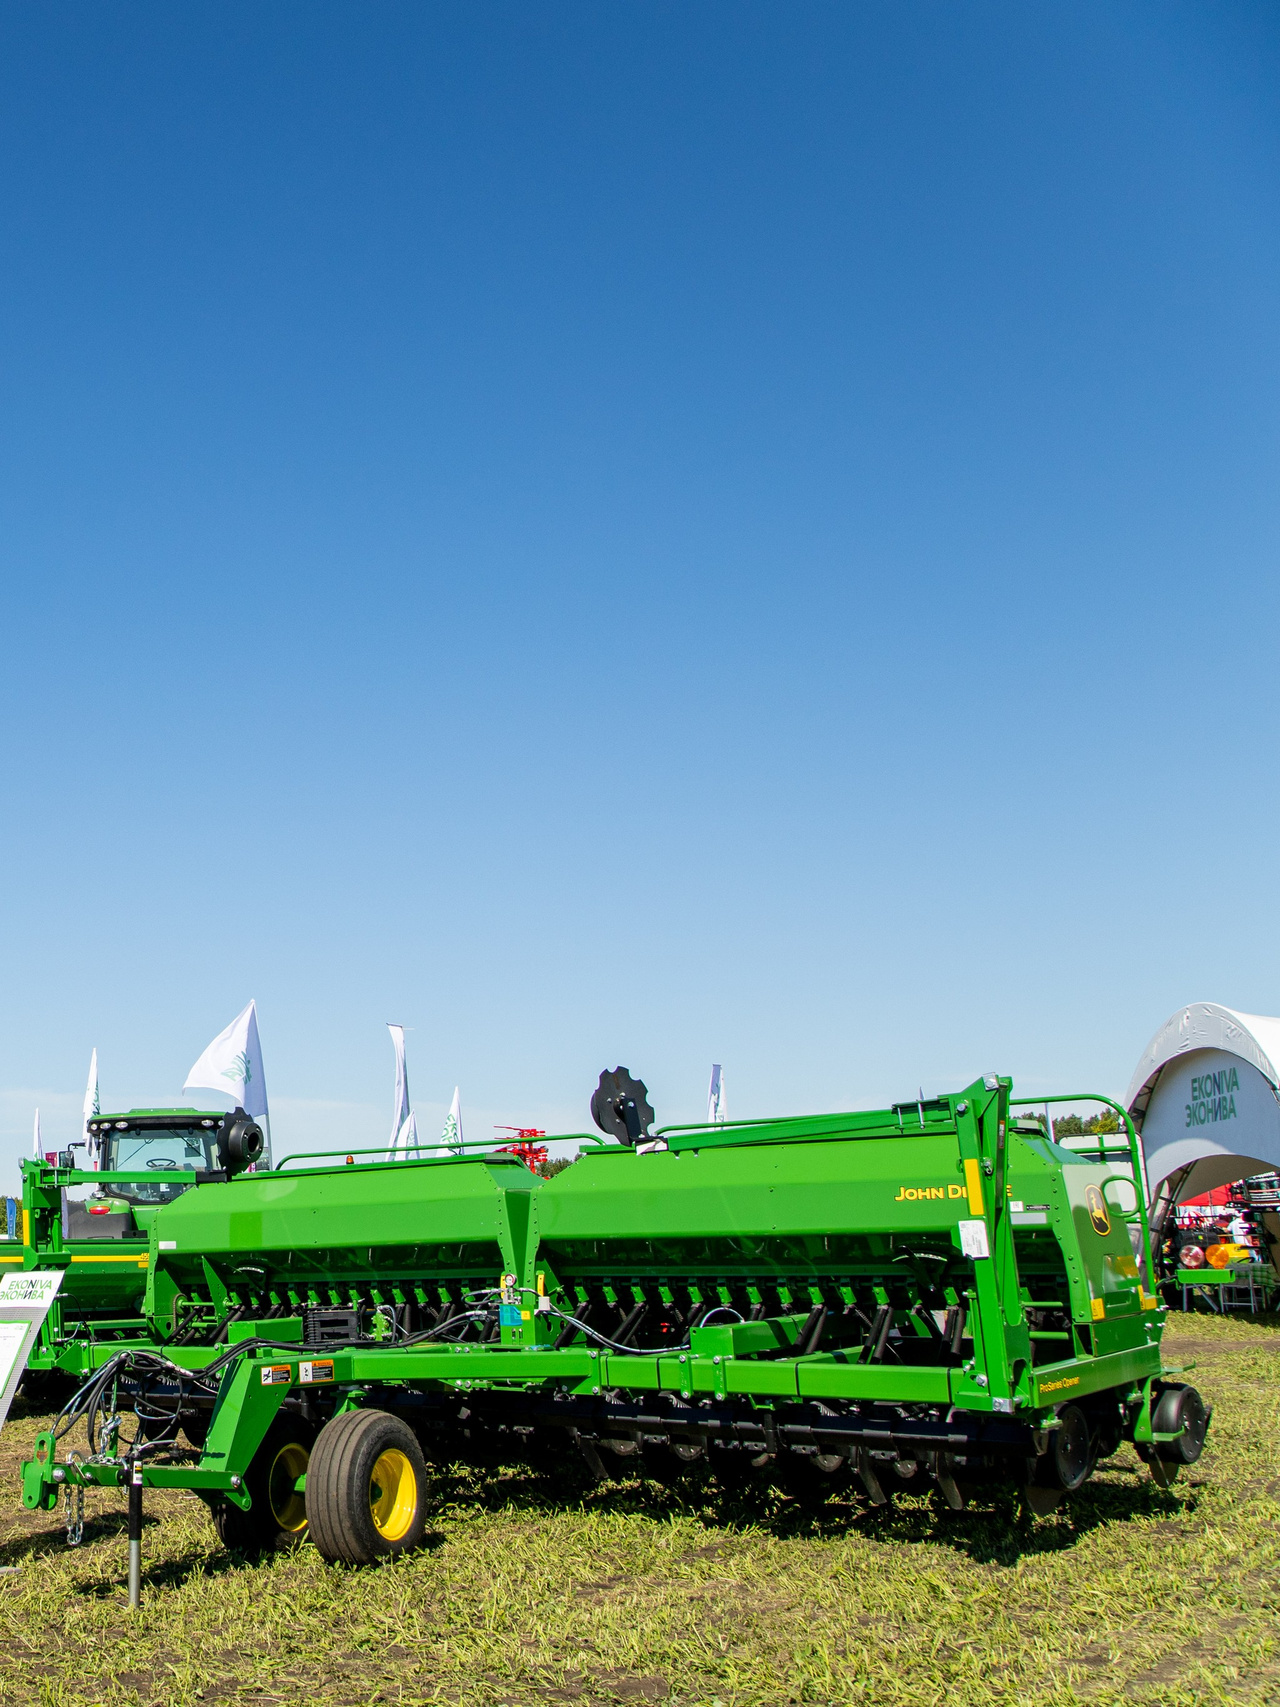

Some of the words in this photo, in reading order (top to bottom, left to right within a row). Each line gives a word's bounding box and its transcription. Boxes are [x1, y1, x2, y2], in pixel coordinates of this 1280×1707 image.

[1191, 1067, 1240, 1101] EKONIVA
[1185, 1094, 1238, 1128] ЭКОНИВА
[894, 1186, 945, 1201] JOHN
[8, 1279, 52, 1290] EKONIVA
